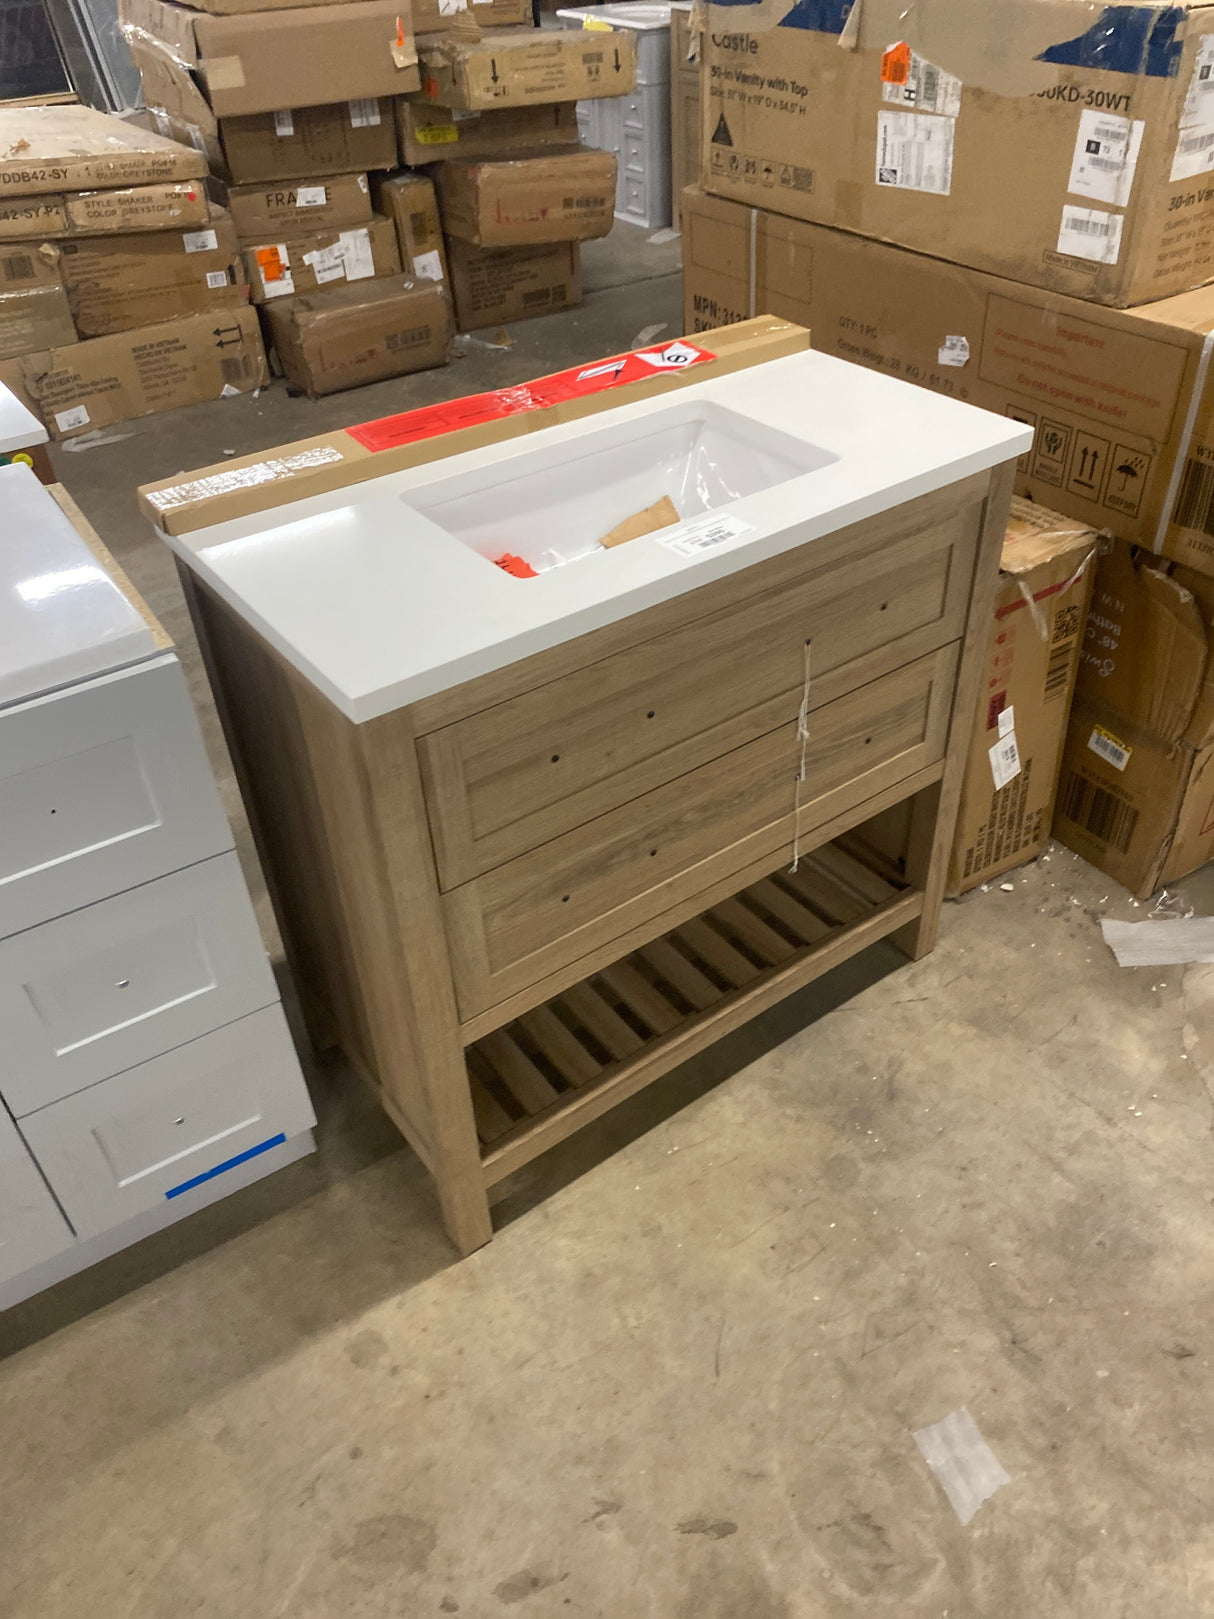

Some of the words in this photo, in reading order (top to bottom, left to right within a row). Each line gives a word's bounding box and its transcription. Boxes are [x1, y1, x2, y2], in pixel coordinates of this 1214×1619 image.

[735, 70, 765, 90] Vanity
[767, 78, 789, 91] with
[790, 81, 808, 98] Top
[0, 168, 68, 184] DDB42-SY
[84, 198, 113, 209] STYLE
[118, 195, 153, 206] SHAKER
[266, 187, 333, 208] FRAE
